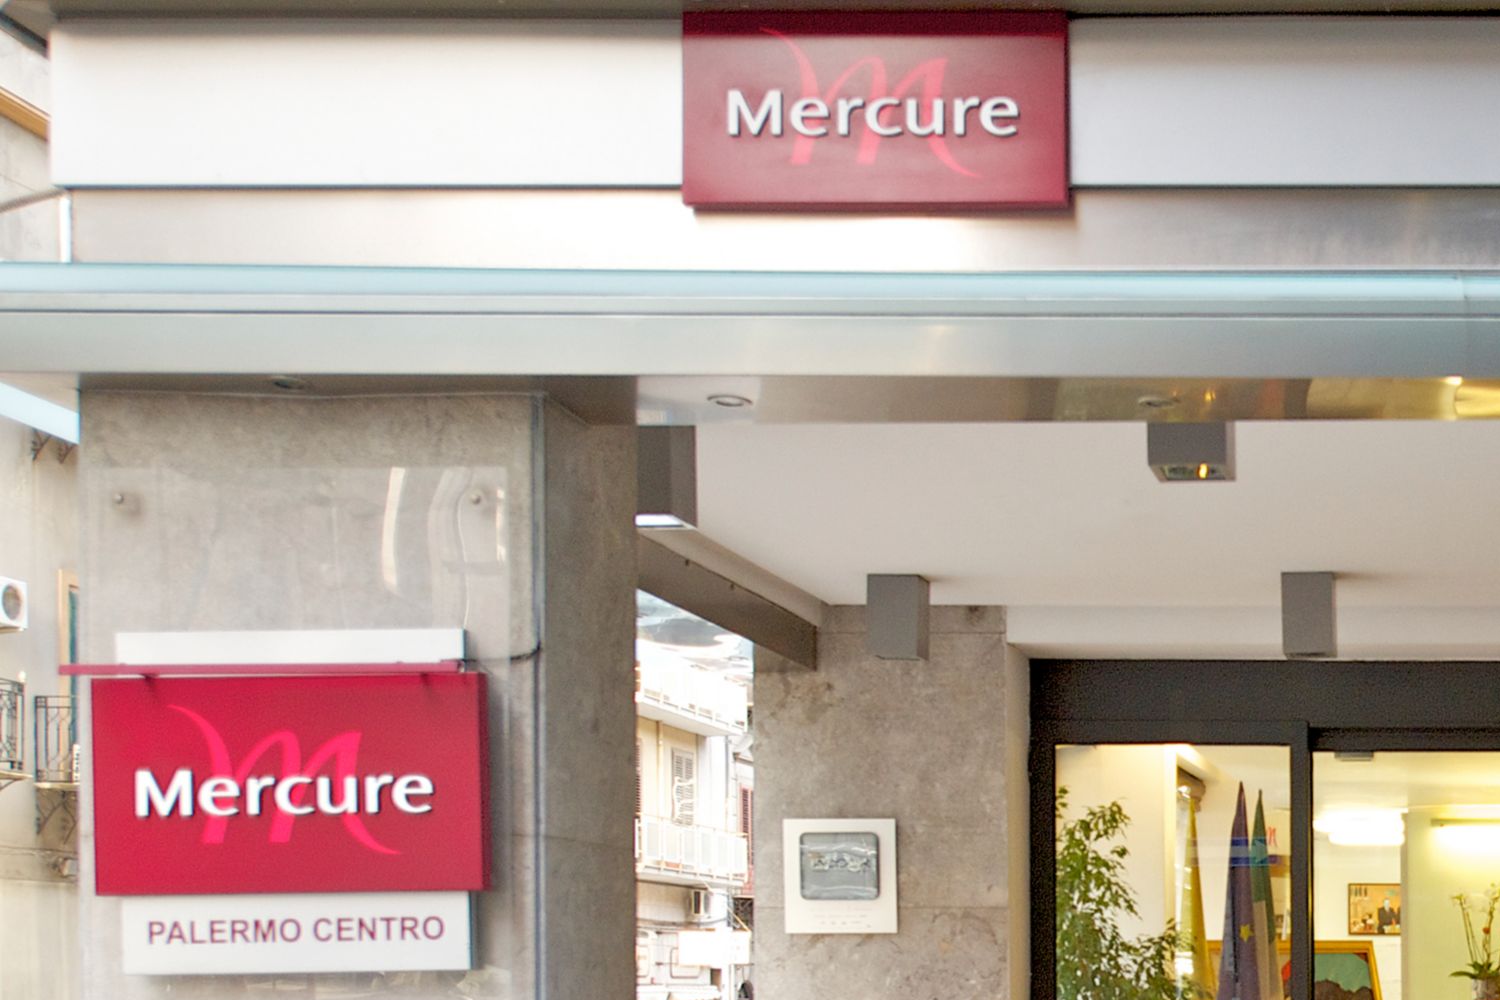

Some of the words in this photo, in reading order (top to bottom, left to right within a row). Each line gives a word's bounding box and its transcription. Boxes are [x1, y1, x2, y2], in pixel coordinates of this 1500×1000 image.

[726, 88, 1020, 138] Mercure
[134, 768, 434, 818] Mercure
[148, 917, 301, 945] PALERMO
[313, 915, 446, 942] CENTRO
